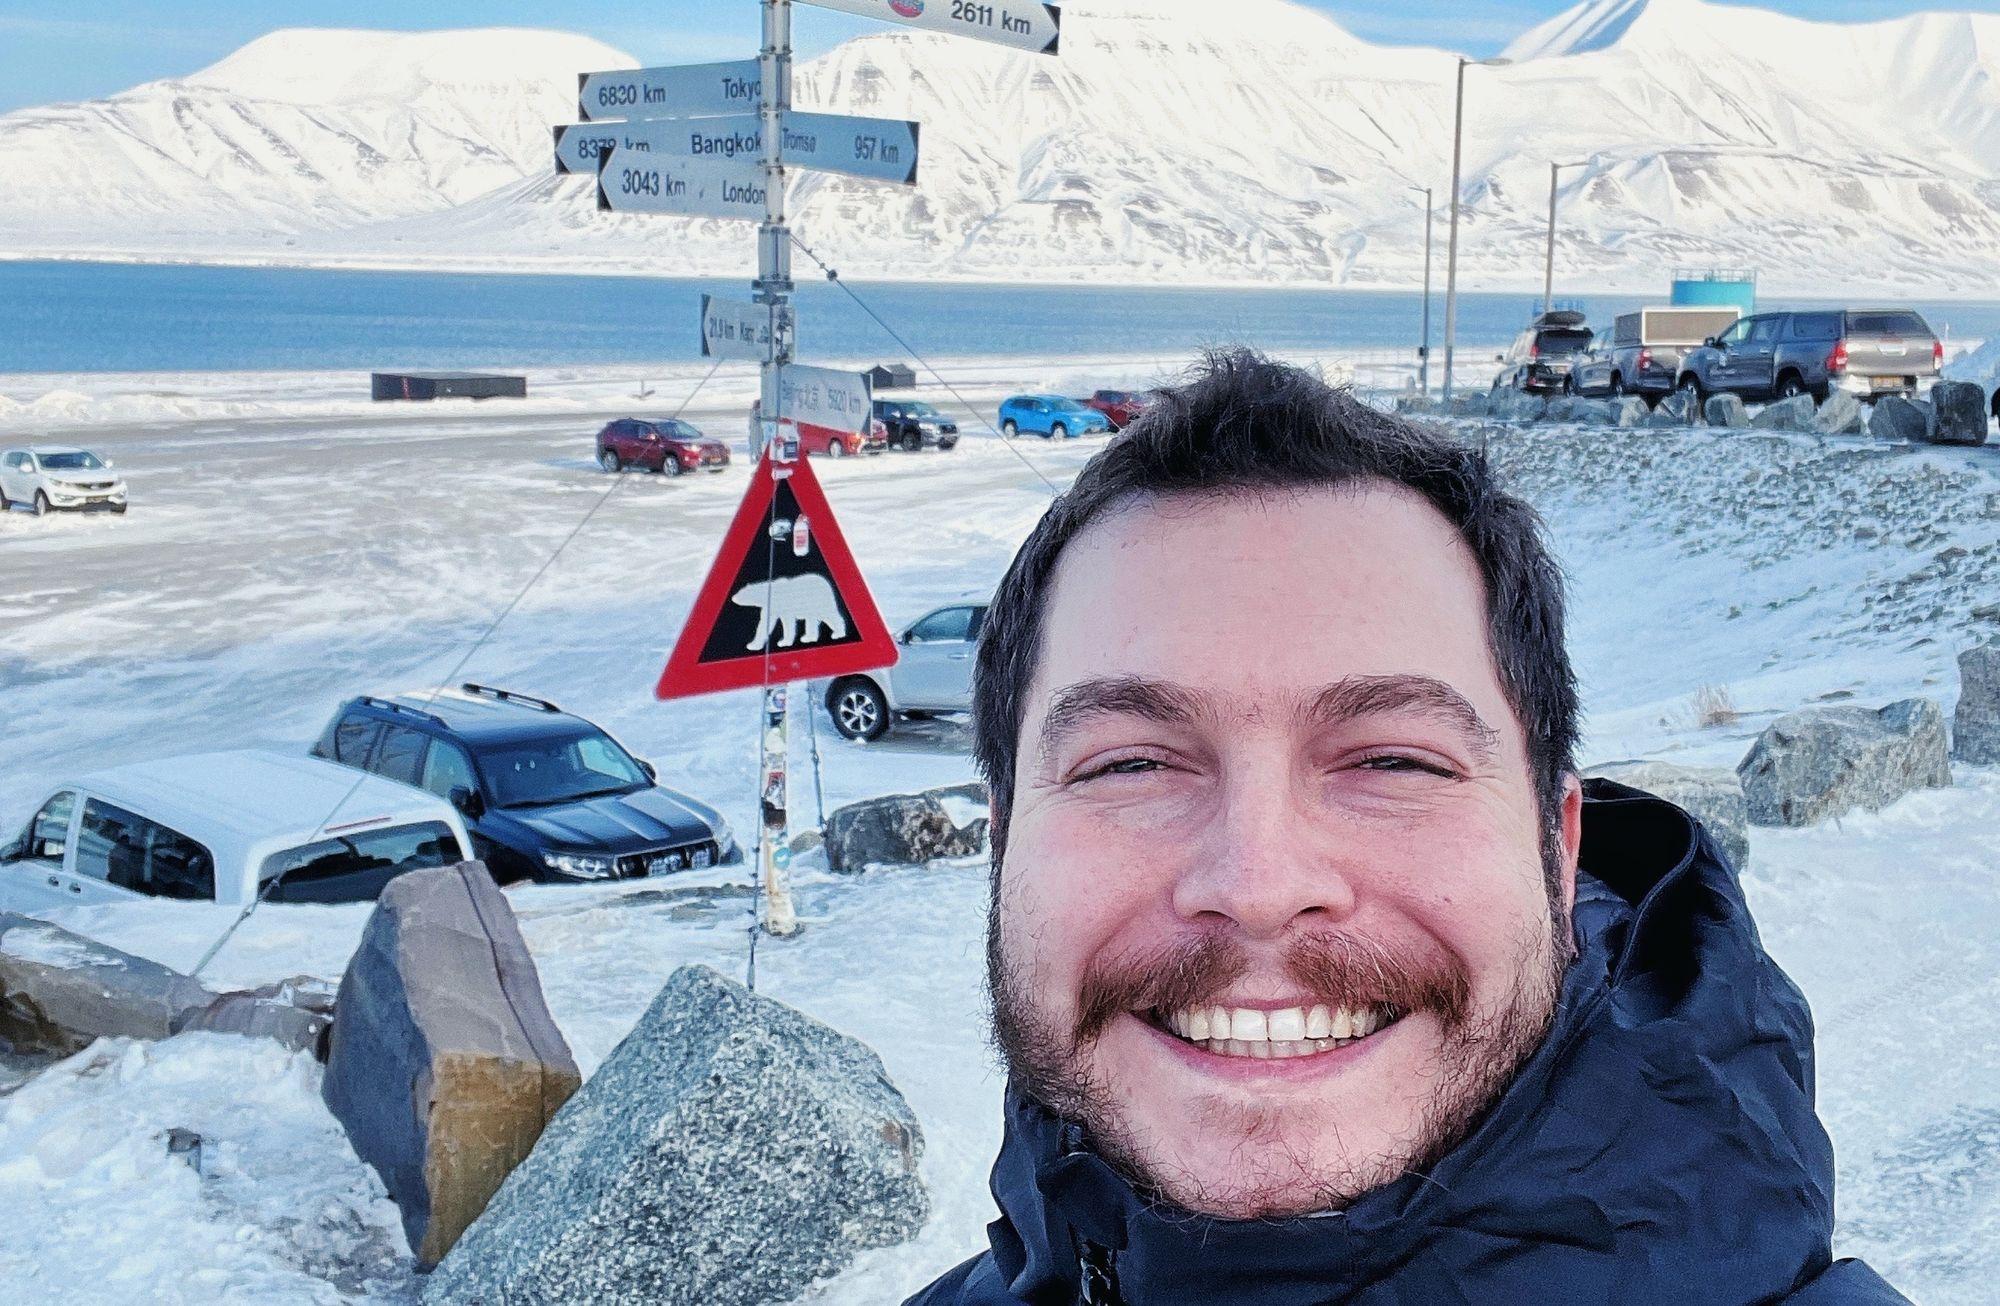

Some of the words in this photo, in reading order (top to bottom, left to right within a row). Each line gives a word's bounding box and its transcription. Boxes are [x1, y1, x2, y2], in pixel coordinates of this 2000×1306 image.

[951, 1, 993, 27] 2611
[1002, 10, 1031, 35] km
[643, 83, 666, 103] km
[722, 78, 762, 101] Tokyo
[691, 131, 762, 158] Bangkok
[855, 135, 876, 161] 957
[881, 139, 899, 164] km
[622, 168, 659, 196] 3043
[666, 174, 686, 196] km
[722, 180, 766, 204] London
